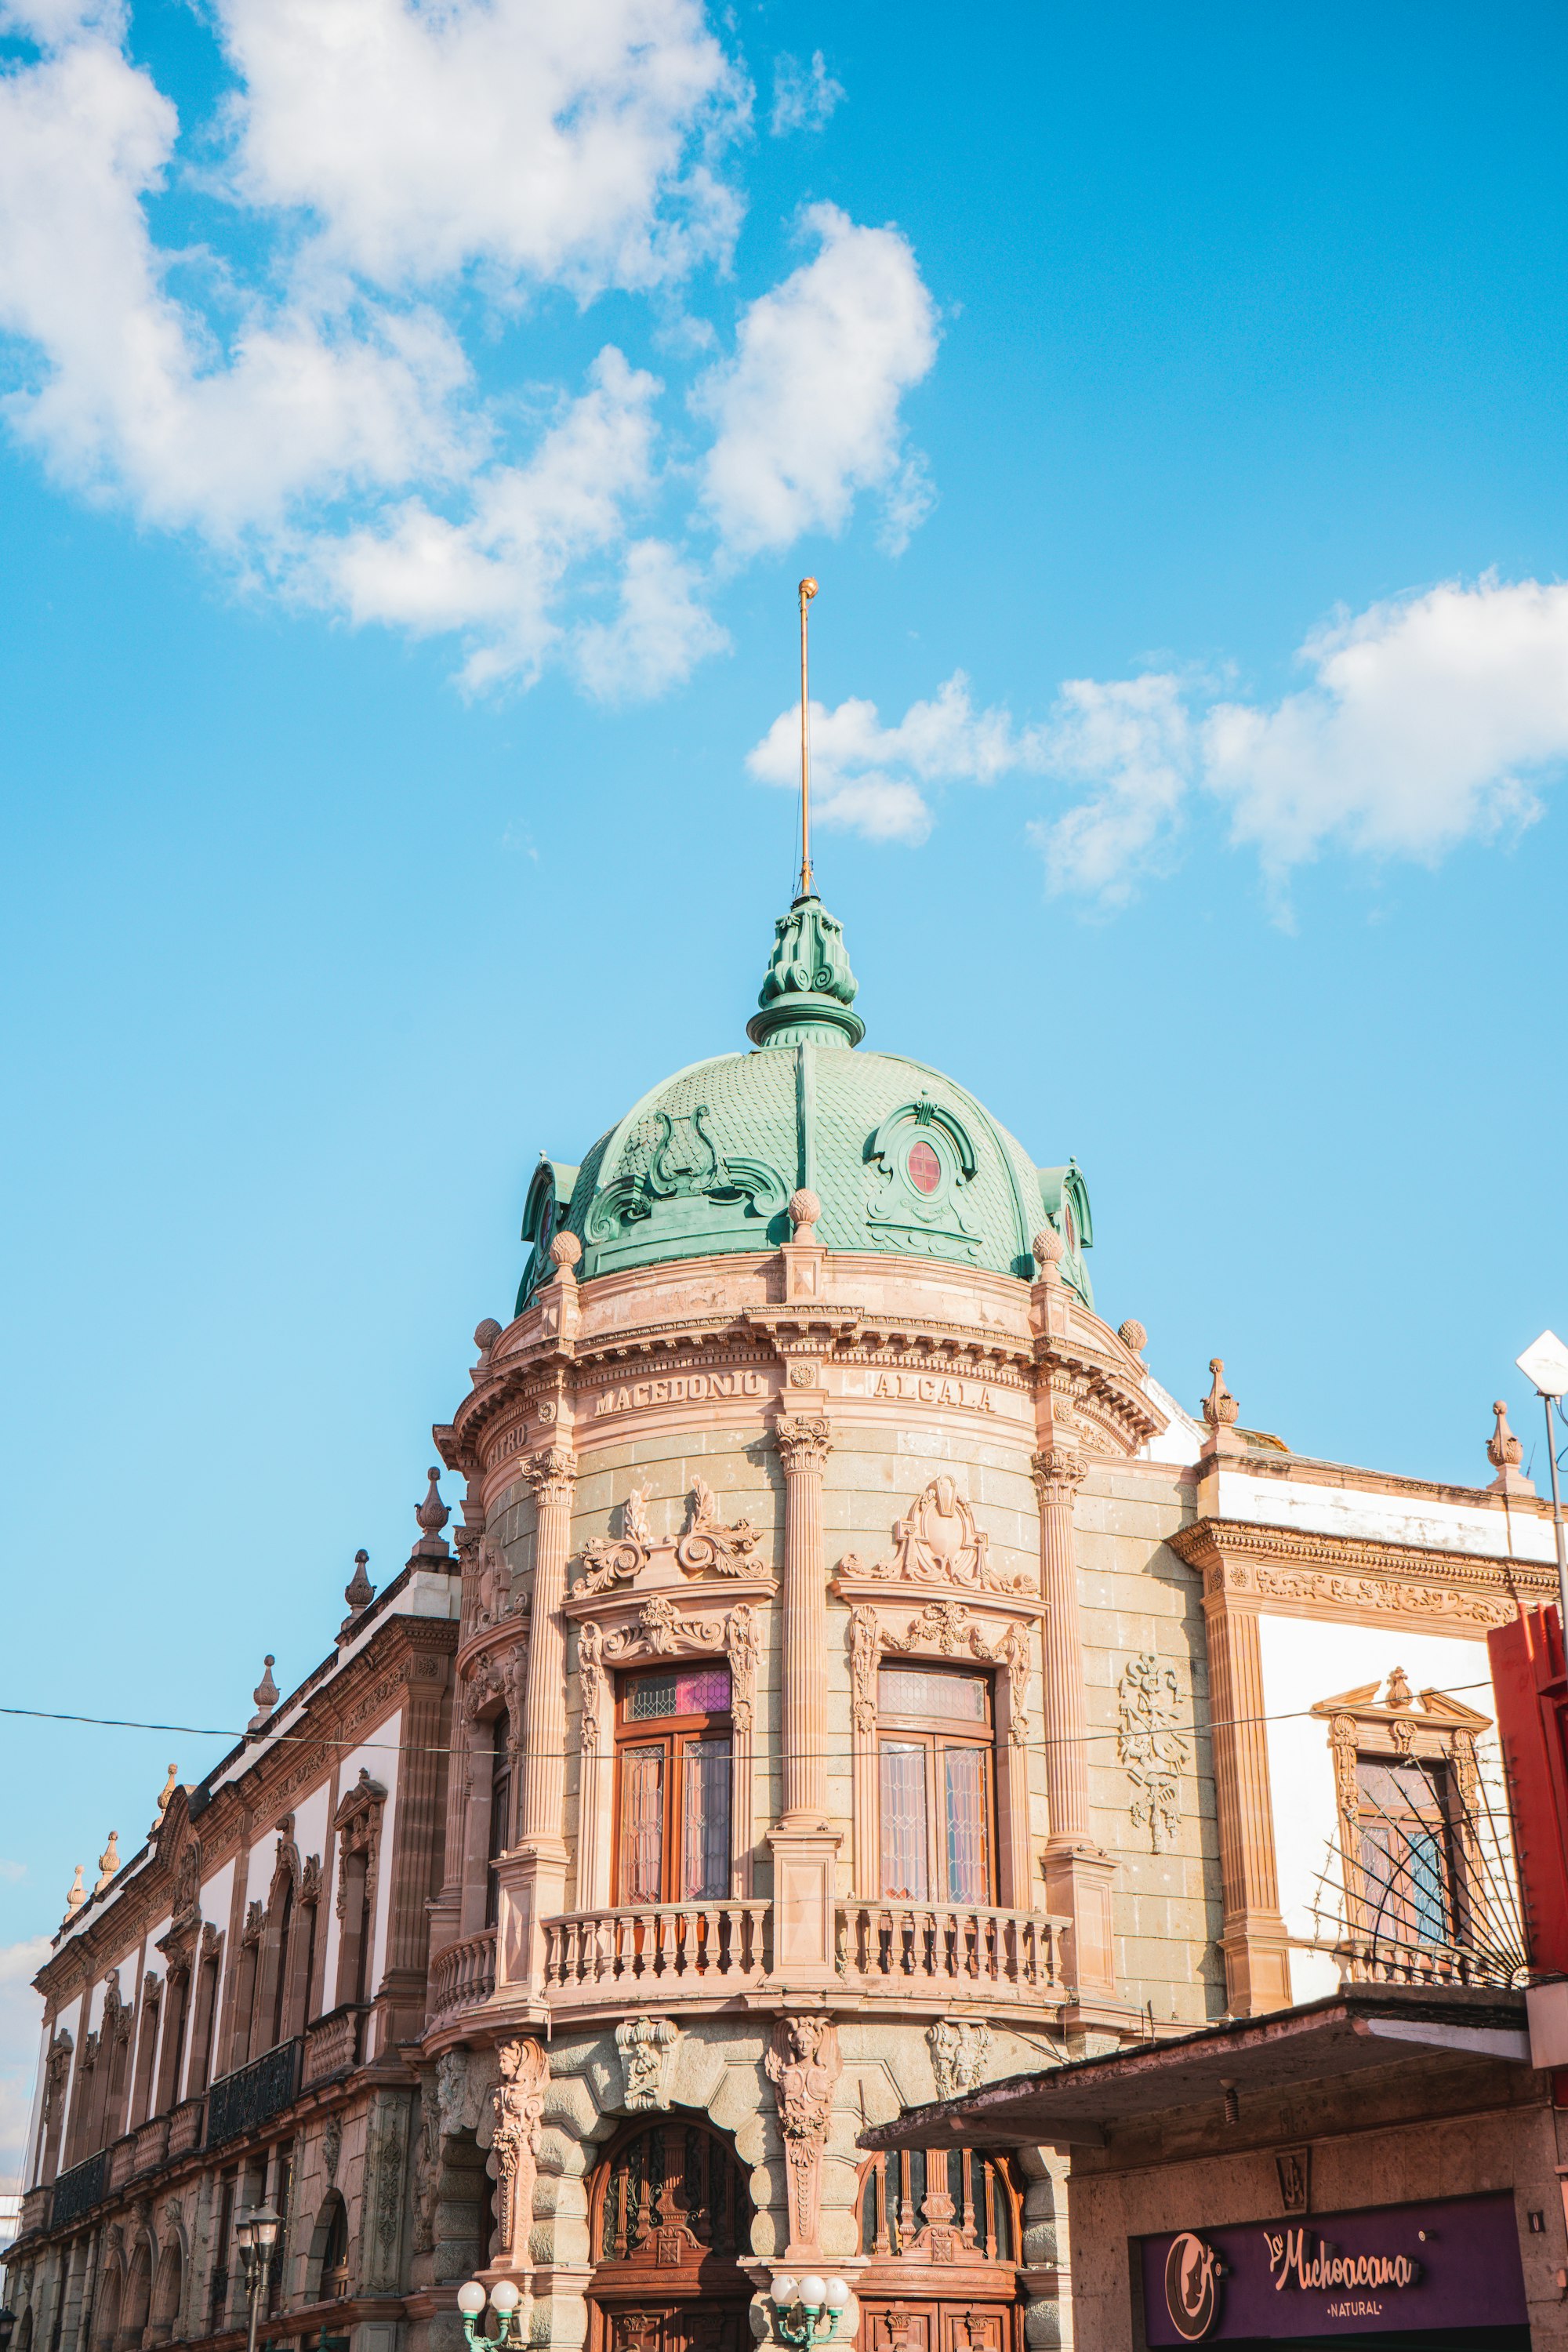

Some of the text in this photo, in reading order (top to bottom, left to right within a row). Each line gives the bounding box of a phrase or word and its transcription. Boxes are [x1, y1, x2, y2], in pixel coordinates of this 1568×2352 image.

[594, 1370, 763, 1417] MACEDONIO
[873, 1373, 996, 1414] ALCALA
[1263, 2228, 1412, 2291] La Michoacana
